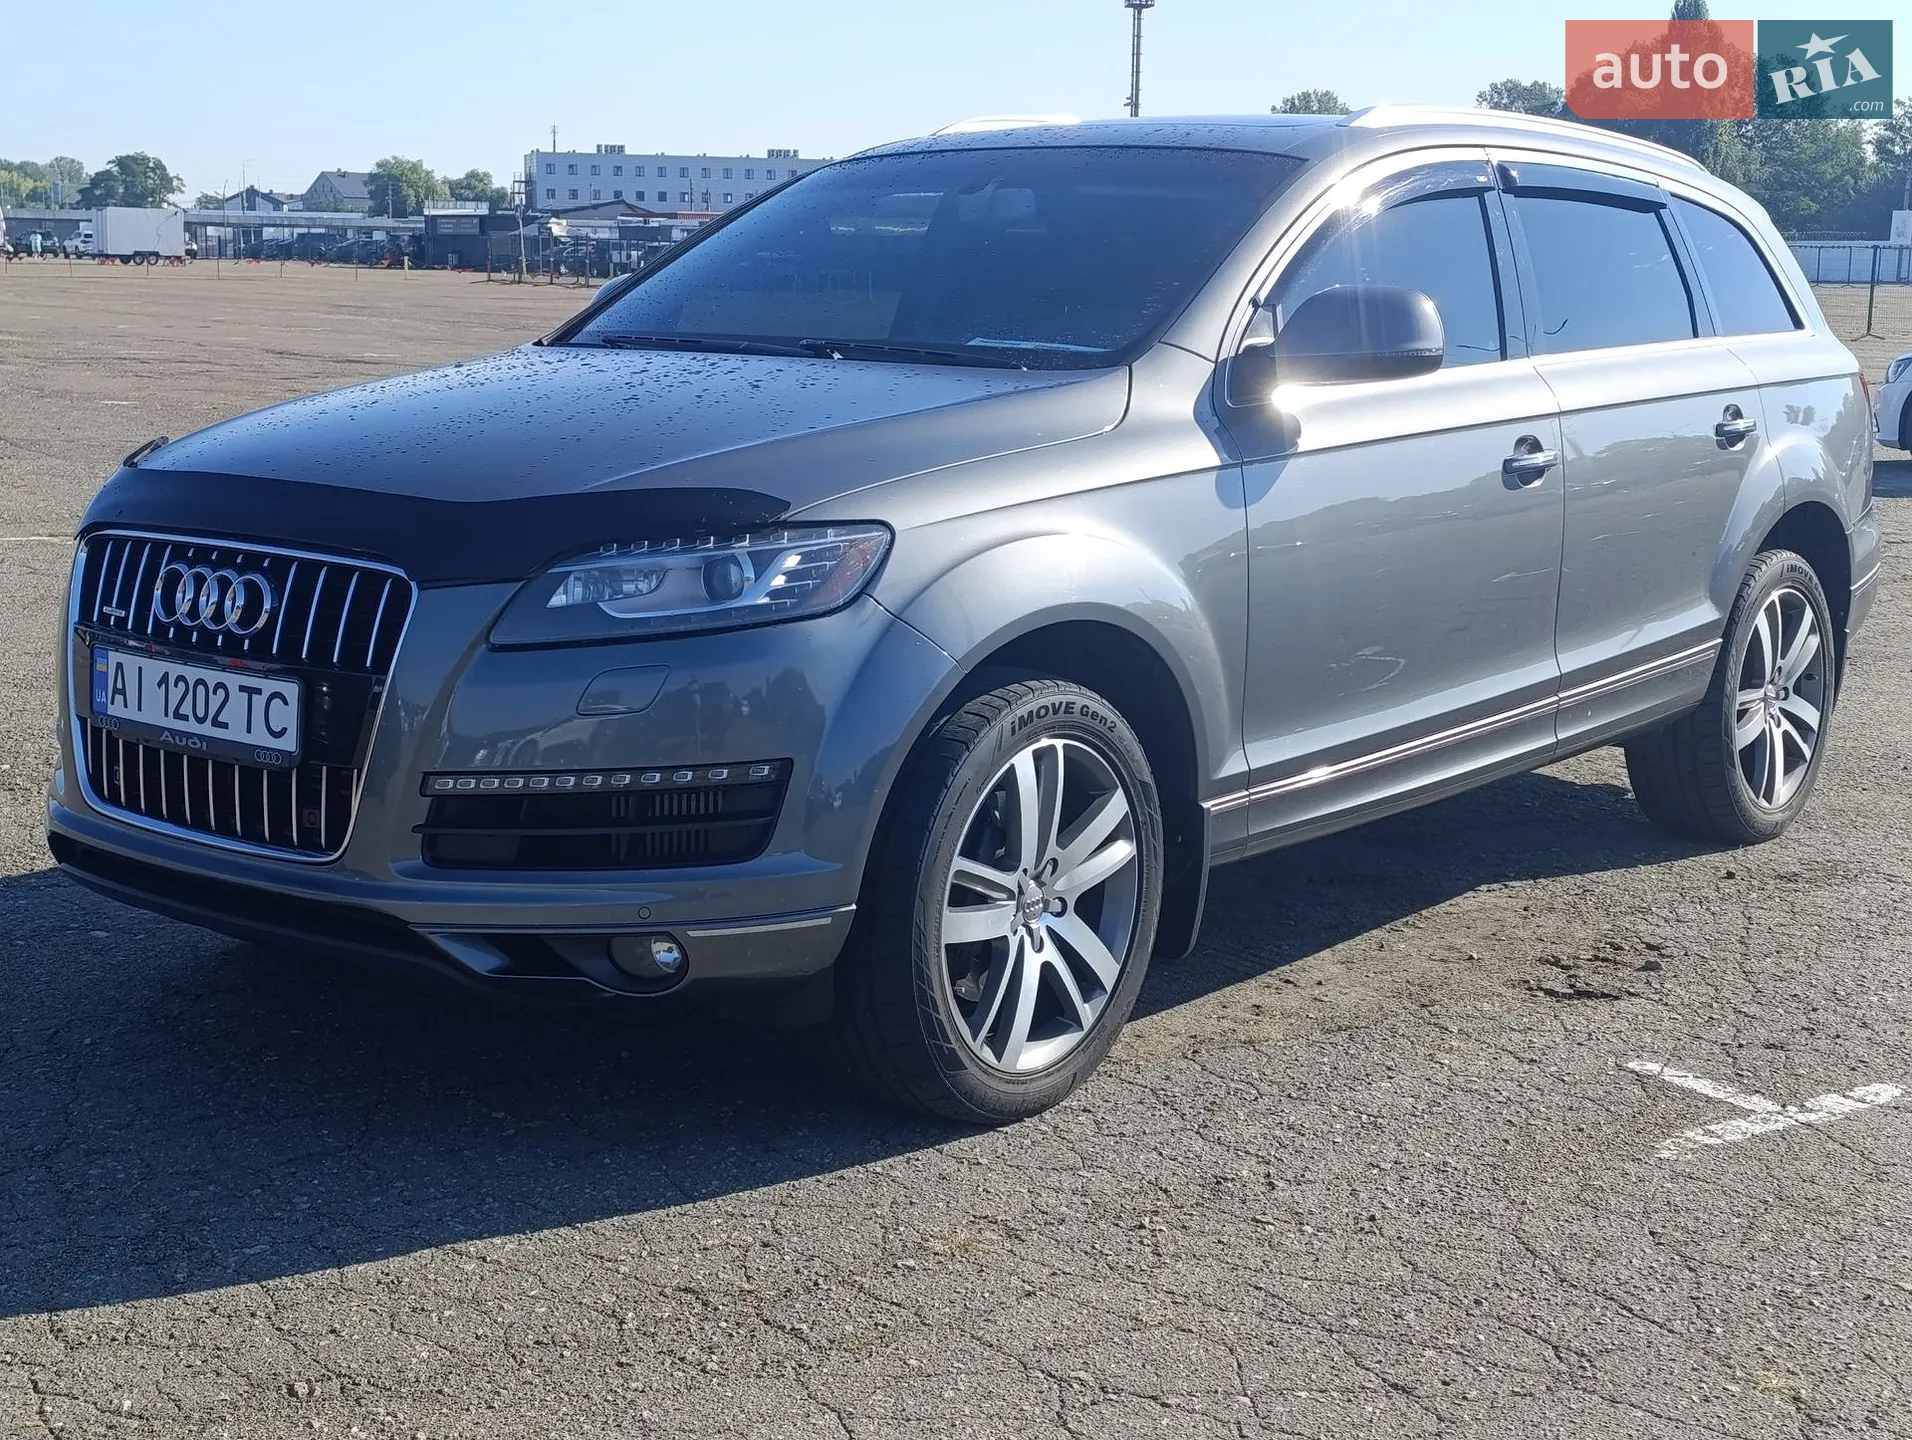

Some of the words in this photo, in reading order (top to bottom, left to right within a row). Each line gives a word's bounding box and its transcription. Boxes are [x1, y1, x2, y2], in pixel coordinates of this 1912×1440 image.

[95, 689, 107, 704] UA
[110, 661, 143, 712] AI
[156, 671, 230, 730] 1202
[238, 685, 290, 739] TC
[1010, 701, 1076, 737] iMOVE
[1079, 704, 1118, 733] Gen2
[159, 730, 207, 750] Audi
